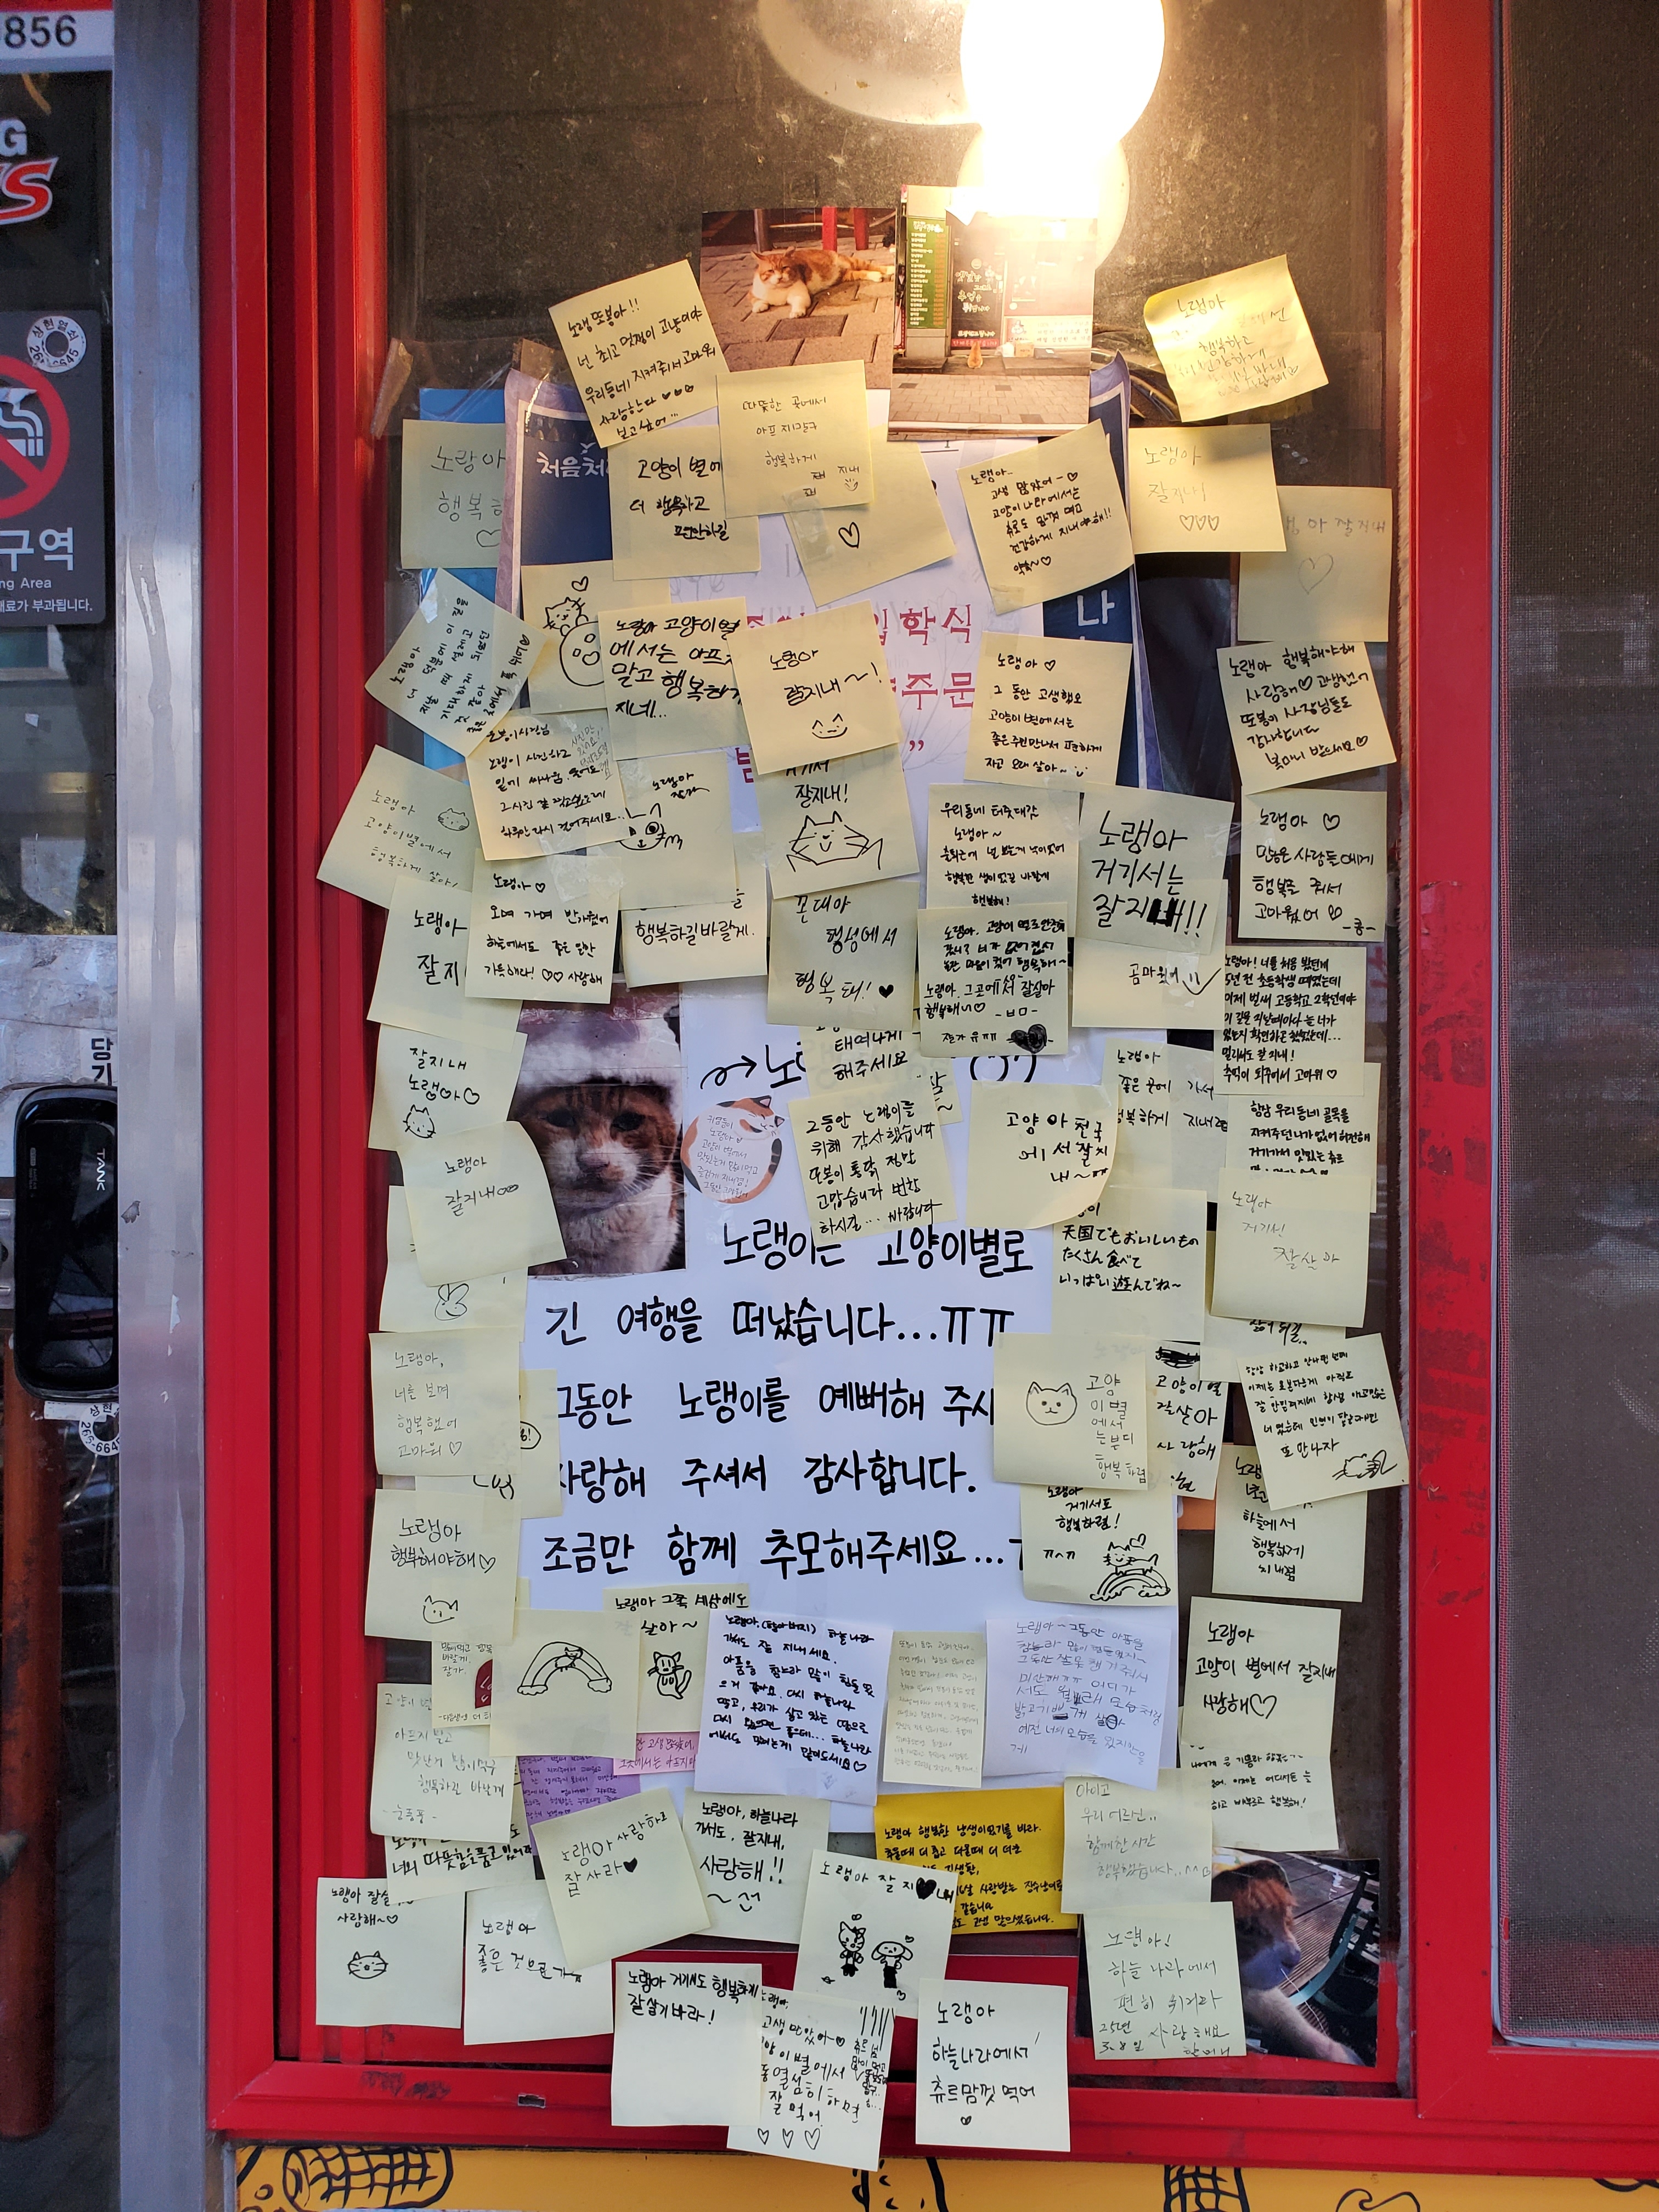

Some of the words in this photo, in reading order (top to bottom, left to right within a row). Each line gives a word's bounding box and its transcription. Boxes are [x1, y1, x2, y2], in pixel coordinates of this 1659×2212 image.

[596, 344, 621, 364] 최고
[597, 394, 659, 427] 사랑한다
[743, 398, 781, 414] 따뜻한
[793, 396, 827, 410] 곳에서
[537, 452, 609, 478] 처음처
[765, 452, 817, 469] 행복하게
[1145, 444, 1204, 467] 노랭아
[638, 457, 682, 481] 고양이
[992, 486, 1009, 500] 고생
[630, 499, 646, 515] 더
[1007, 532, 1053, 555] 건강하게
[21, 577, 52, 589] Area
[32, 599, 93, 613] 부과됩니다.
[610, 640, 679, 665] 에서는
[998, 653, 1039, 670] 노랭아
[612, 662, 655, 689] 말고
[1229, 658, 1273, 679] 노랭아
[1246, 684, 1299, 704] 사랑해
[1240, 710, 1279, 730] 또봉이
[1282, 693, 1353, 719] 사장님들도
[985, 758, 1005, 770] 자고
[1012, 759, 1030, 770] 오래
[373, 790, 416, 816] 노랭아
[941, 803, 986, 820] 우리동네
[991, 805, 1040, 821] 터줏대감
[1260, 809, 1308, 832] 노랭아
[1099, 810, 1189, 855] 노랭아
[987, 847, 1000, 860] 널
[1257, 845, 1293, 865] 많은
[1294, 848, 1374, 868] 사람들에게
[494, 873, 532, 891] 노랭아
[1092, 859, 1184, 897] 거기서는
[1252, 876, 1300, 899] 행복을
[1310, 878, 1343, 896] 줘서
[414, 910, 468, 938] 노랭아
[491, 905, 515, 921] 오며
[524, 910, 553, 921] 가며
[565, 910, 609, 927] 반가웠어
[1255, 903, 1319, 925] 고마웠어
[986, 920, 1014, 934] 고양이
[487, 935, 540, 953] 하늘에서도
[552, 940, 572, 956] 좋은
[966, 960, 990, 972] 마음이
[568, 972, 603, 988] 사랑해
[1225, 972, 1242, 987] 5년
[1243, 973, 1254, 986] 전
[1257, 973, 1297, 989] 초등학생
[1250, 992, 1273, 1010] 벌써
[1276, 992, 1313, 1008] 고등학교
[410, 1048, 467, 1071] 잘지내
[1119, 1074, 1140, 1094] 좋은
[1223, 1064, 1250, 1084] 추억이
[1295, 1069, 1324, 1083] 고마워
[409, 1074, 461, 1102] 노랭아
[806, 1112, 852, 1135] 그동안
[864, 1101, 915, 1125] 노랭이를
[1250, 1101, 1272, 1119] 항상
[1324, 1107, 1350, 1124] 골목을
[811, 1139, 842, 1160] 위해
[852, 1121, 936, 1153] 감사했습니다
[445, 1157, 487, 1175] 노랭아
[810, 1165, 844, 1186] 또봉이
[850, 1156, 880, 1182] 통닭
[885, 1150, 917, 1168] 정말
[817, 1181, 884, 1211] 고맙습니다
[892, 1177, 922, 1198] 번창
[1233, 1192, 1271, 1214] 노랭아
[1062, 1224, 1199, 1251] 天国でもおいしいもの
[1063, 1247, 1142, 1269] たくさん食べて
[546, 1304, 588, 1346] 긴
[617, 1296, 703, 1344] 여행을
[395, 1384, 416, 1403] 너를
[426, 1384, 449, 1400] 보며
[679, 1377, 791, 1425] 노랭이를
[820, 1378, 925, 1421] 예뻐해
[398, 1415, 458, 1435] 행복했어
[399, 1442, 442, 1458] 고마워
[560, 1457, 646, 1504] 사랑해
[682, 1454, 767, 1498] 주셔서
[804, 1449, 977, 1497] 감사합니다.
[1063, 1496, 1113, 1512] 거기서도
[399, 1519, 462, 1543] 노랭아
[1243, 1509, 1296, 1532] 하늘에서
[543, 1533, 636, 1575] 조금만
[668, 1524, 737, 1577] 함께
[616, 1596, 657, 1612] 노랭아
[662, 1593, 688, 1610] 그쪽
[695, 1593, 749, 1610] 세상에도
[1208, 1622, 1255, 1647] 노랭아
[1245, 1657, 1291, 1680] 별에서
[751, 1702, 779, 1713] 우리가
[786, 1707, 804, 1723] 살고
[1204, 1691, 1250, 1716] 사랑해
[1076, 1782, 1111, 1798] 아이고
[750, 1808, 799, 1828] 하늘나라
[562, 1840, 613, 1869] 노랭아
[618, 1812, 668, 1841] 사랑하고
[885, 1828, 912, 1841] 노랭아
[918, 1824, 950, 1838] 행복한
[1132, 1833, 1156, 1848] 시간
[332, 1887, 362, 1905] 노랭아
[980, 1882, 1018, 1895] 사랑받는
[483, 1920, 537, 1936] 노랭아
[629, 1970, 667, 1994] 노랭아
[712, 1976, 760, 2005] 행복하게
[938, 2002, 996, 2025] 노랭아
[1099, 2021, 1132, 2035] 25년
[1150, 2023, 1231, 2051] 사랑해요
[933, 2037, 1029, 2071] 하늘나라에서
[1002, 2085, 1036, 2103] 먹어
